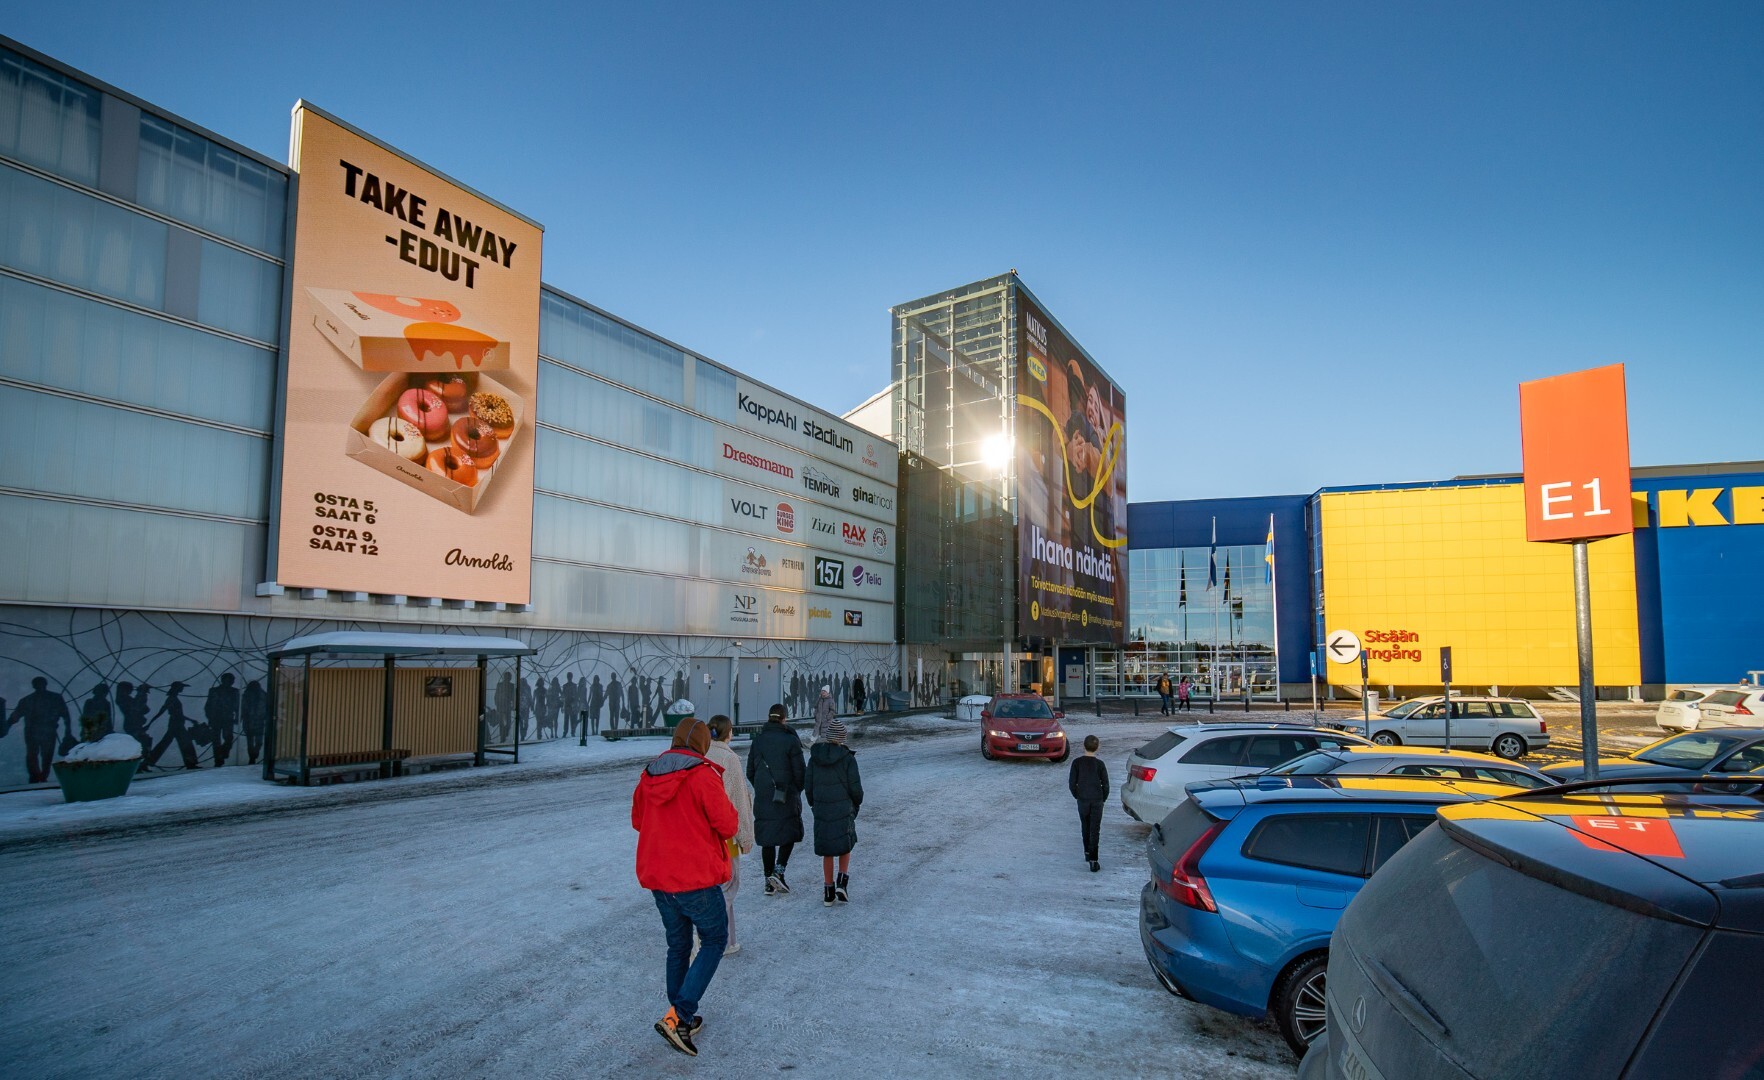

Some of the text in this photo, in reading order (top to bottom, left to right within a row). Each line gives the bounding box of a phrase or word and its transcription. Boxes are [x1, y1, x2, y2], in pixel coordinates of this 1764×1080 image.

[340, 159, 517, 268] TAKE AWAY
[385, 229, 479, 289] -EDUT
[1026, 311, 1047, 346] MATKUS
[738, 392, 797, 431] KappAhl
[803, 420, 853, 454] stadium
[723, 443, 794, 479] Dressmann
[803, 476, 840, 498] TEMPUR
[314, 492, 378, 513] OSTA 5,
[731, 499, 768, 520] VOLT
[1541, 477, 1611, 521] E1
[315, 506, 376, 524] SAAT 6
[776, 511, 794, 520] BURGER
[776, 516, 794, 528] KING
[312, 524, 376, 544] OSTA 9,
[811, 517, 836, 535] Zizzi
[842, 522, 866, 543] RAX
[309, 538, 378, 556] SAAT 12
[1031, 524, 1114, 583] Ihana nähdä.
[444, 548, 513, 571] Arnolds
[816, 560, 842, 585] 157
[865, 572, 882, 586] Telia
[1031, 575, 1066, 595] Toivottavasti
[733, 594, 757, 610] NP
[808, 605, 832, 619] picnic
[1364, 629, 1419, 643] Sisään
[1365, 643, 1422, 662] Ingång
